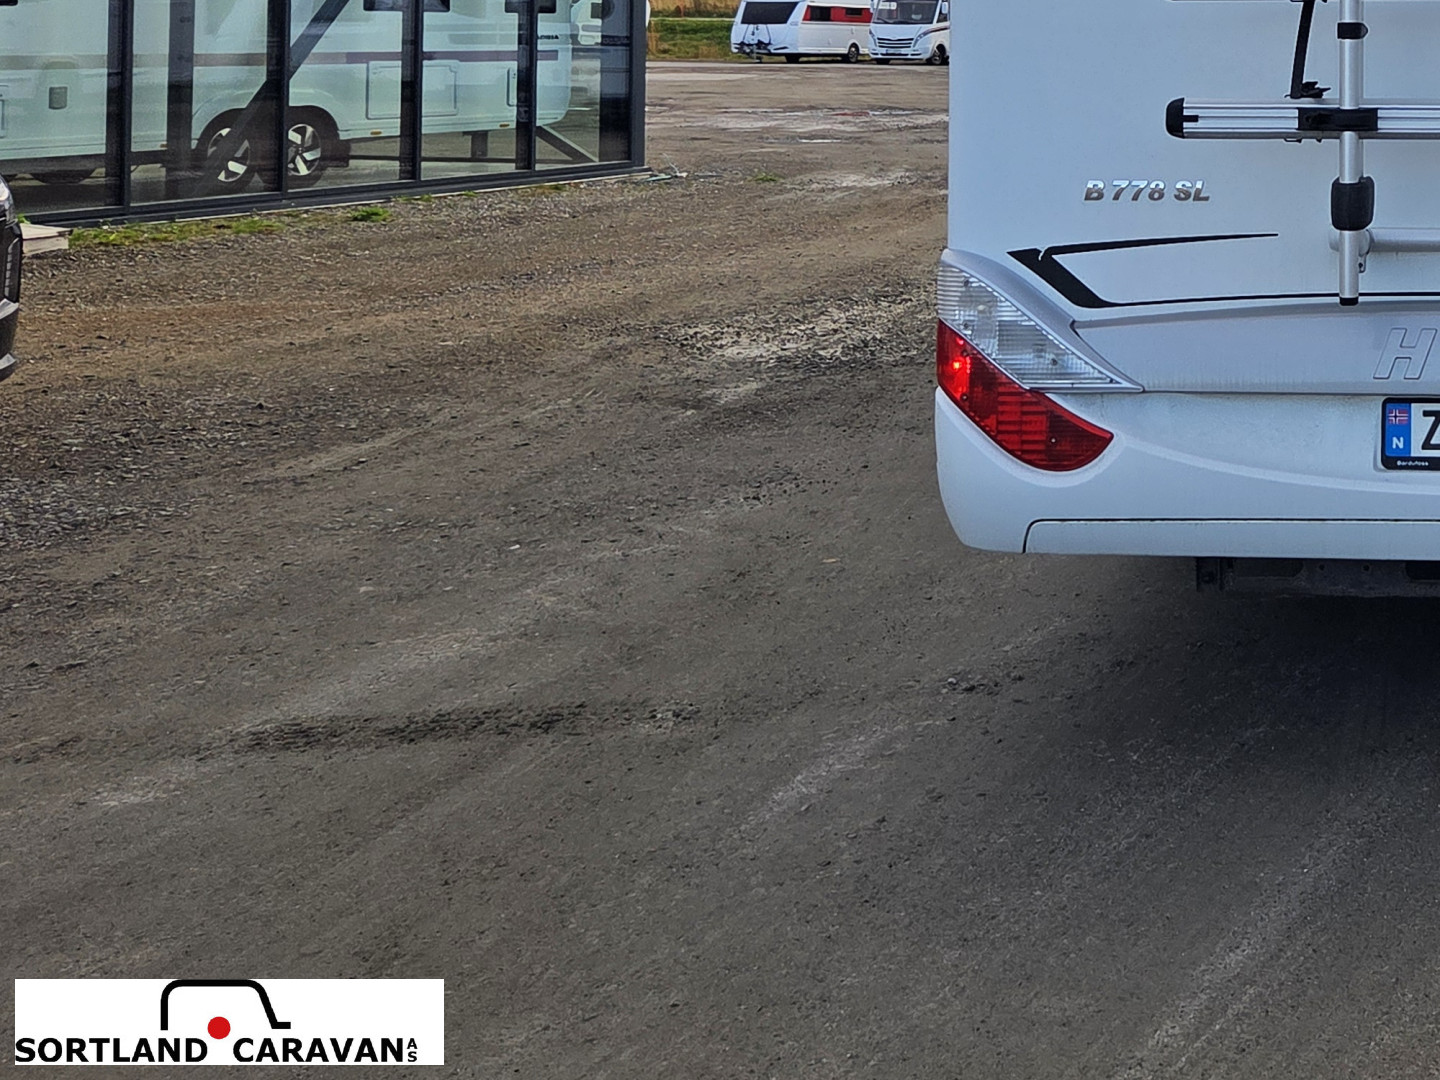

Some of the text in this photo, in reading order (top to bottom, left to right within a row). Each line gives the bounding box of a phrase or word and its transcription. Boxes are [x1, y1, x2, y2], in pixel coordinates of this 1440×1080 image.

[1084, 180, 1210, 201] B 778 SL
[1392, 437, 1404, 449] N
